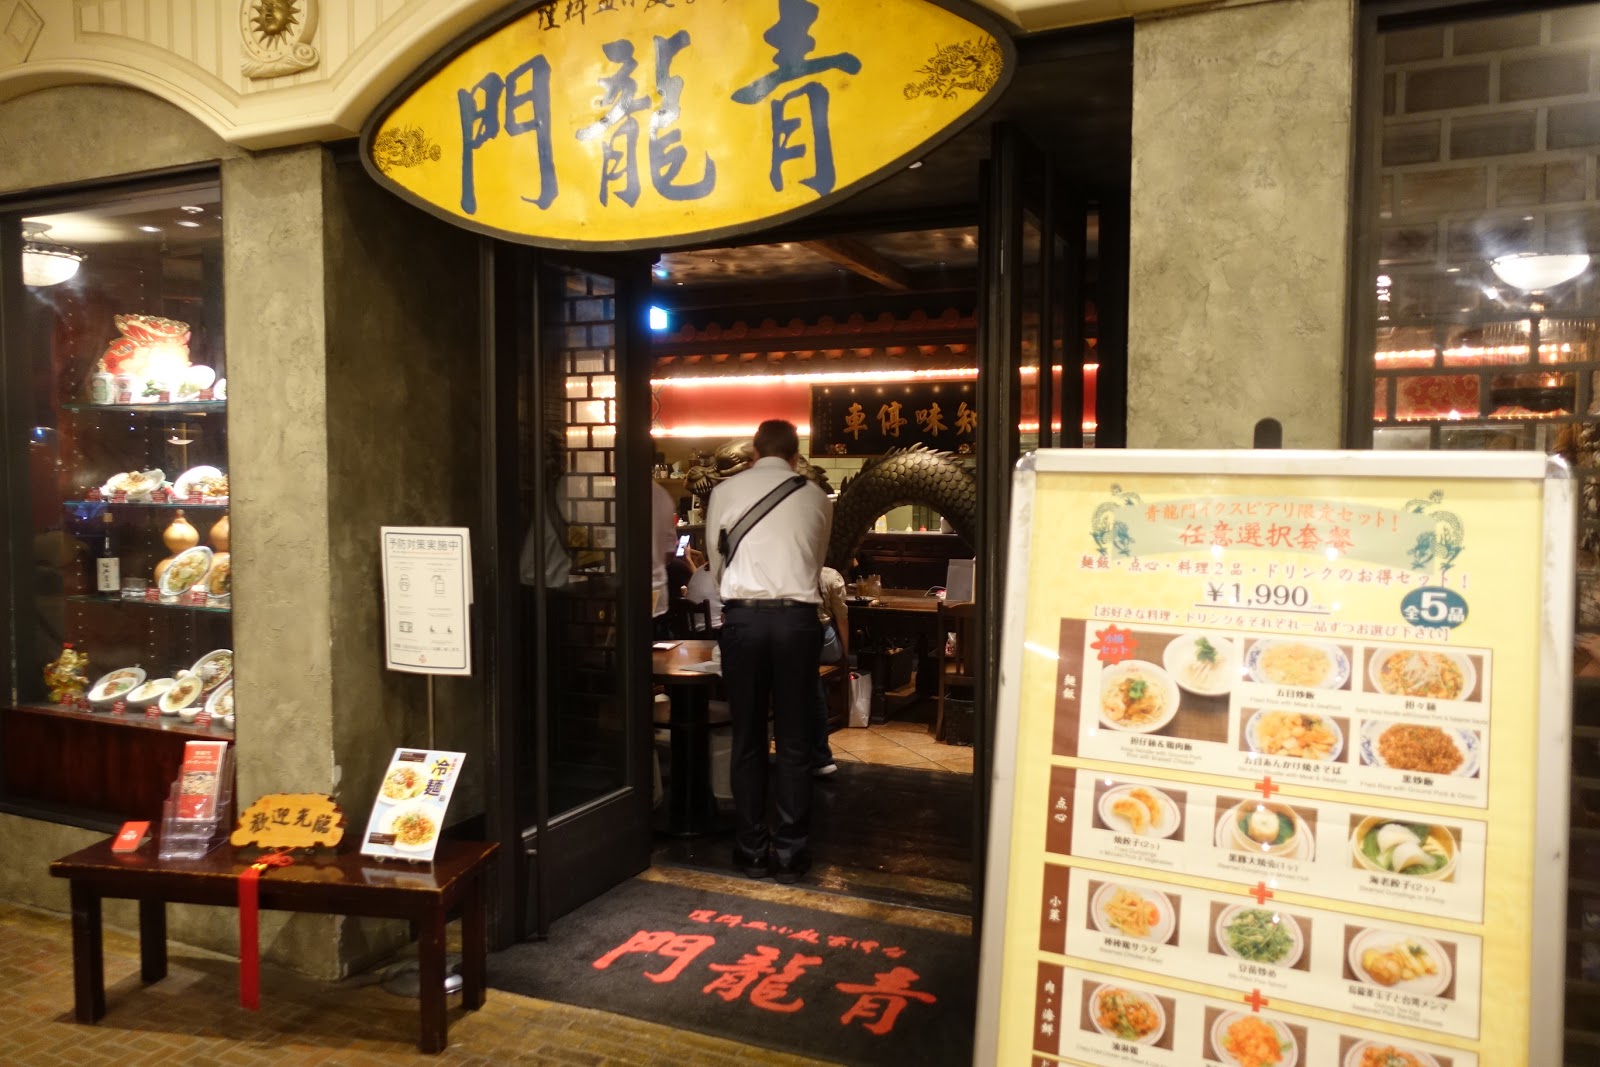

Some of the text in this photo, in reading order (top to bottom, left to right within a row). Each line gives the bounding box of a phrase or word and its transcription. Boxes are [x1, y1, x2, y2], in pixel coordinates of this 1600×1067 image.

[389, 537, 459, 551] 予防対策実施中
[1207, 582, 1309, 607] ¥1,990
[1402, 591, 1466, 624] 全5品
